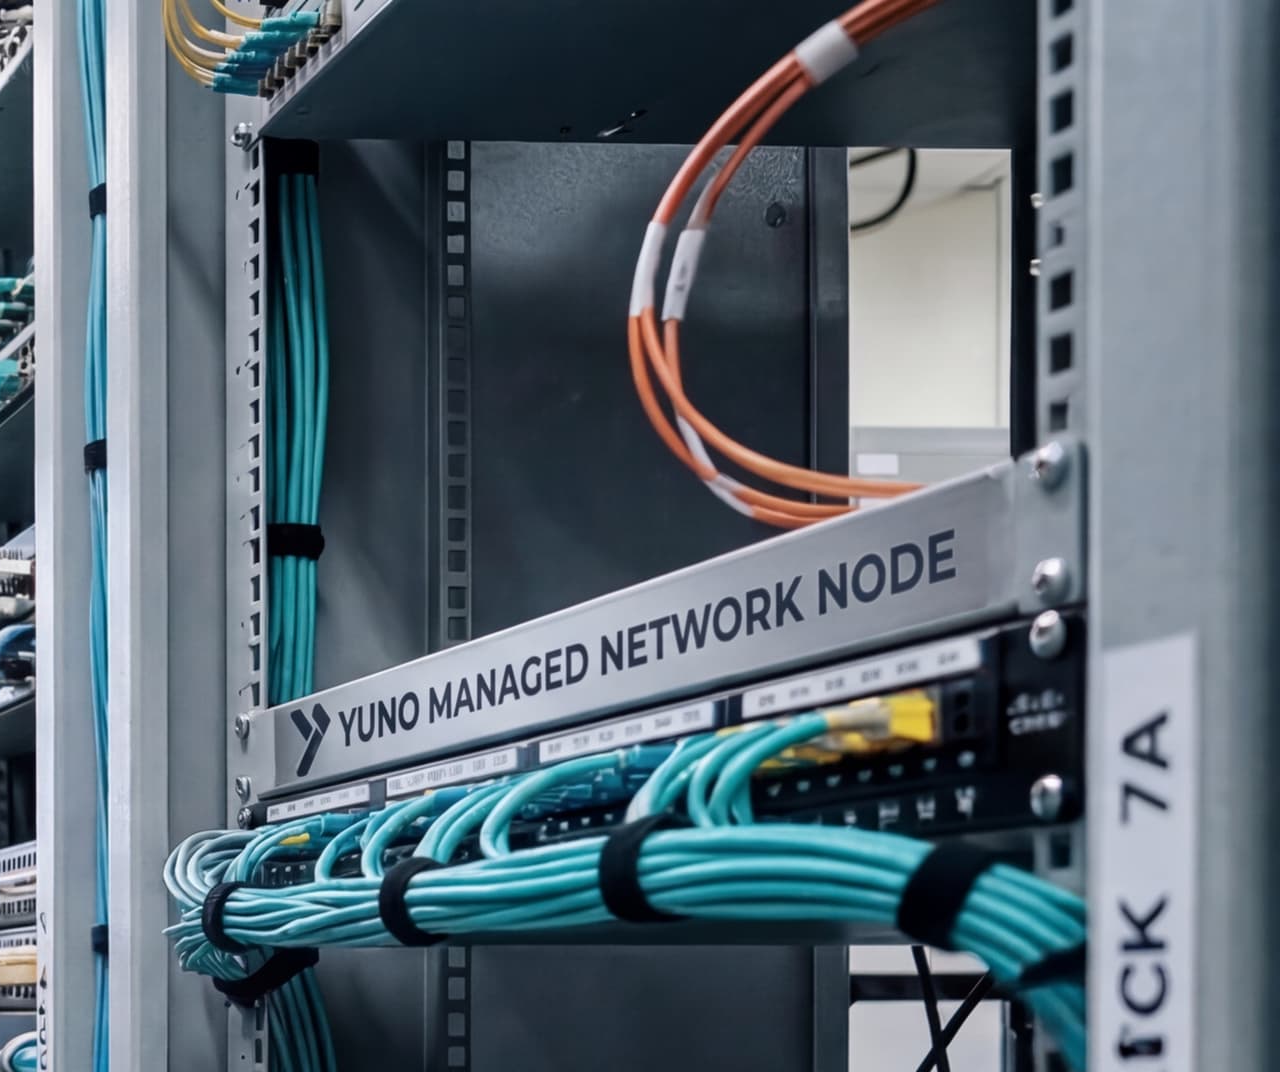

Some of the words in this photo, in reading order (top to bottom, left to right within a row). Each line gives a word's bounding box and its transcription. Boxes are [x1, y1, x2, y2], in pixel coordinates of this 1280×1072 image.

[338, 691, 420, 747] YUNO
[428, 642, 589, 724] MANAGED
[600, 575, 805, 676] NETWORK
[817, 528, 957, 616] NODE
[1119, 710, 1169, 826] 7A
